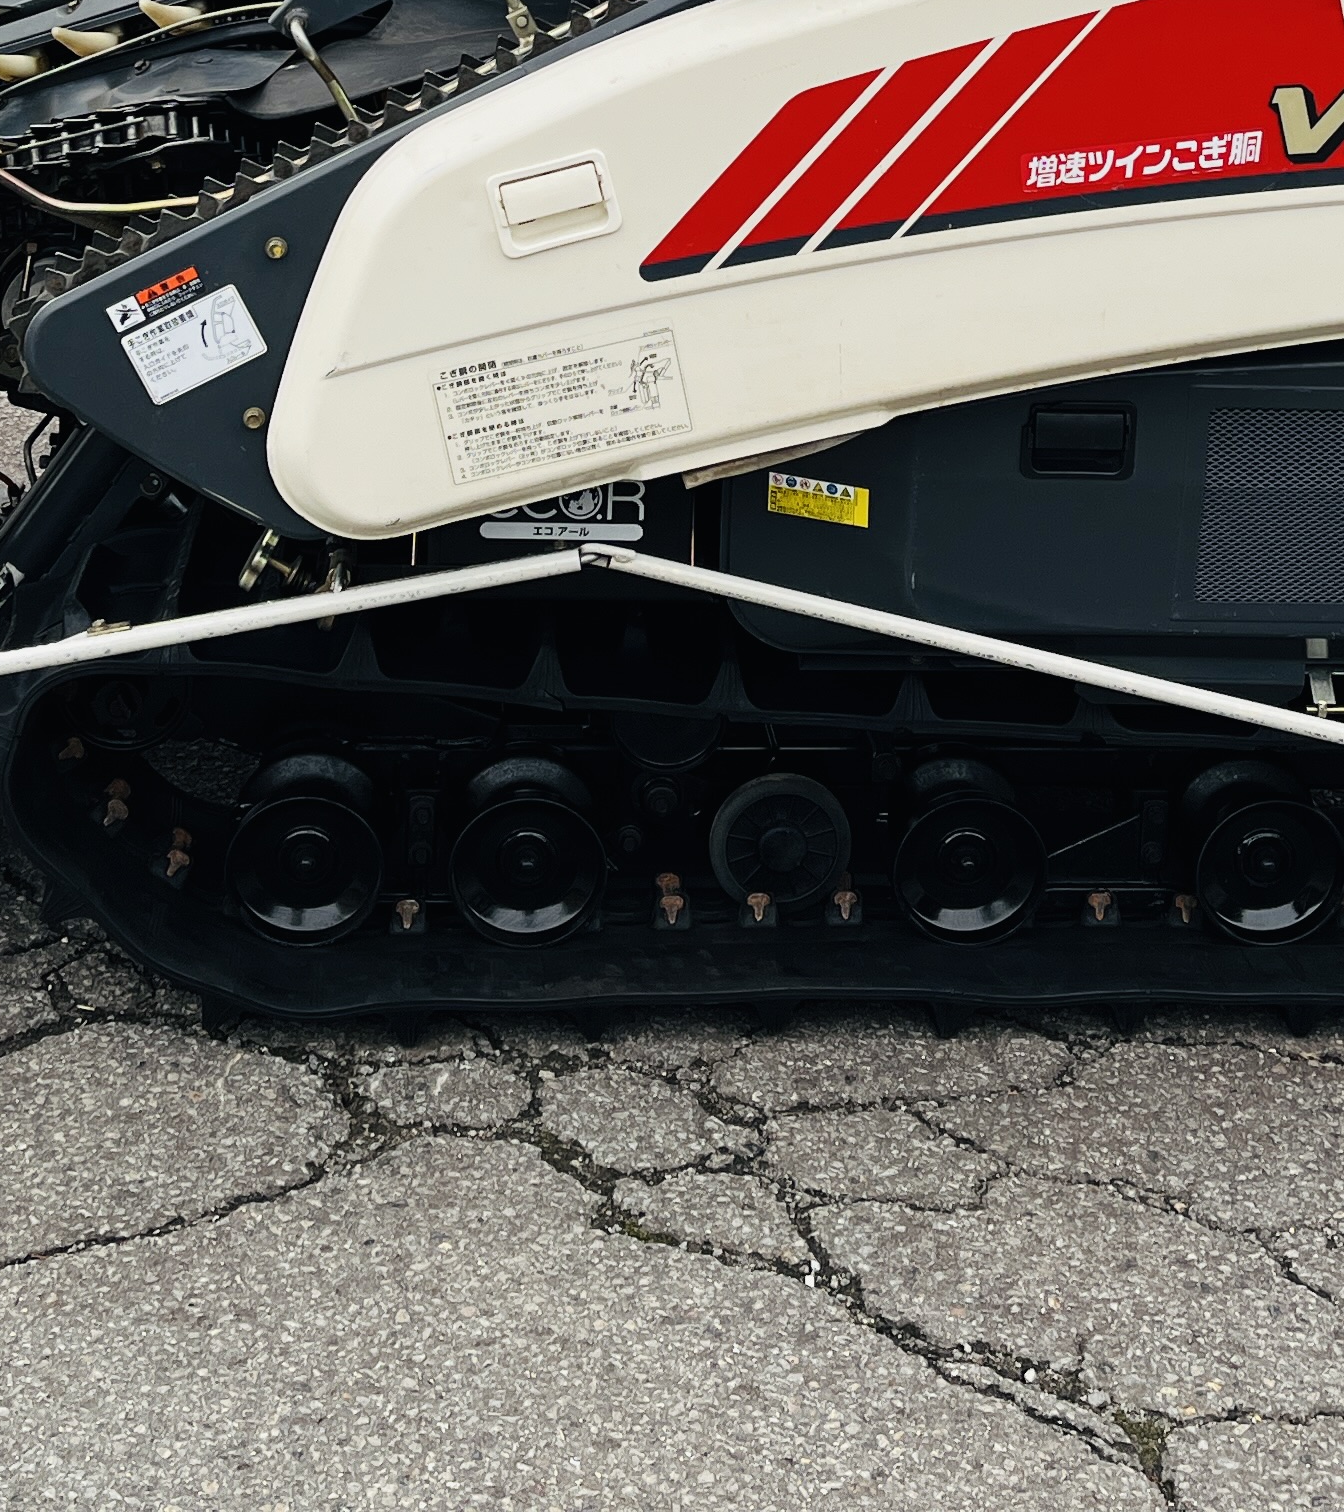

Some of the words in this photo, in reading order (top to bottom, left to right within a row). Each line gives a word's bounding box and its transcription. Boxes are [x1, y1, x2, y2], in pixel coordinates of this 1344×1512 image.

[1027, 133, 1263, 189] 増速ツインこぎ胴
